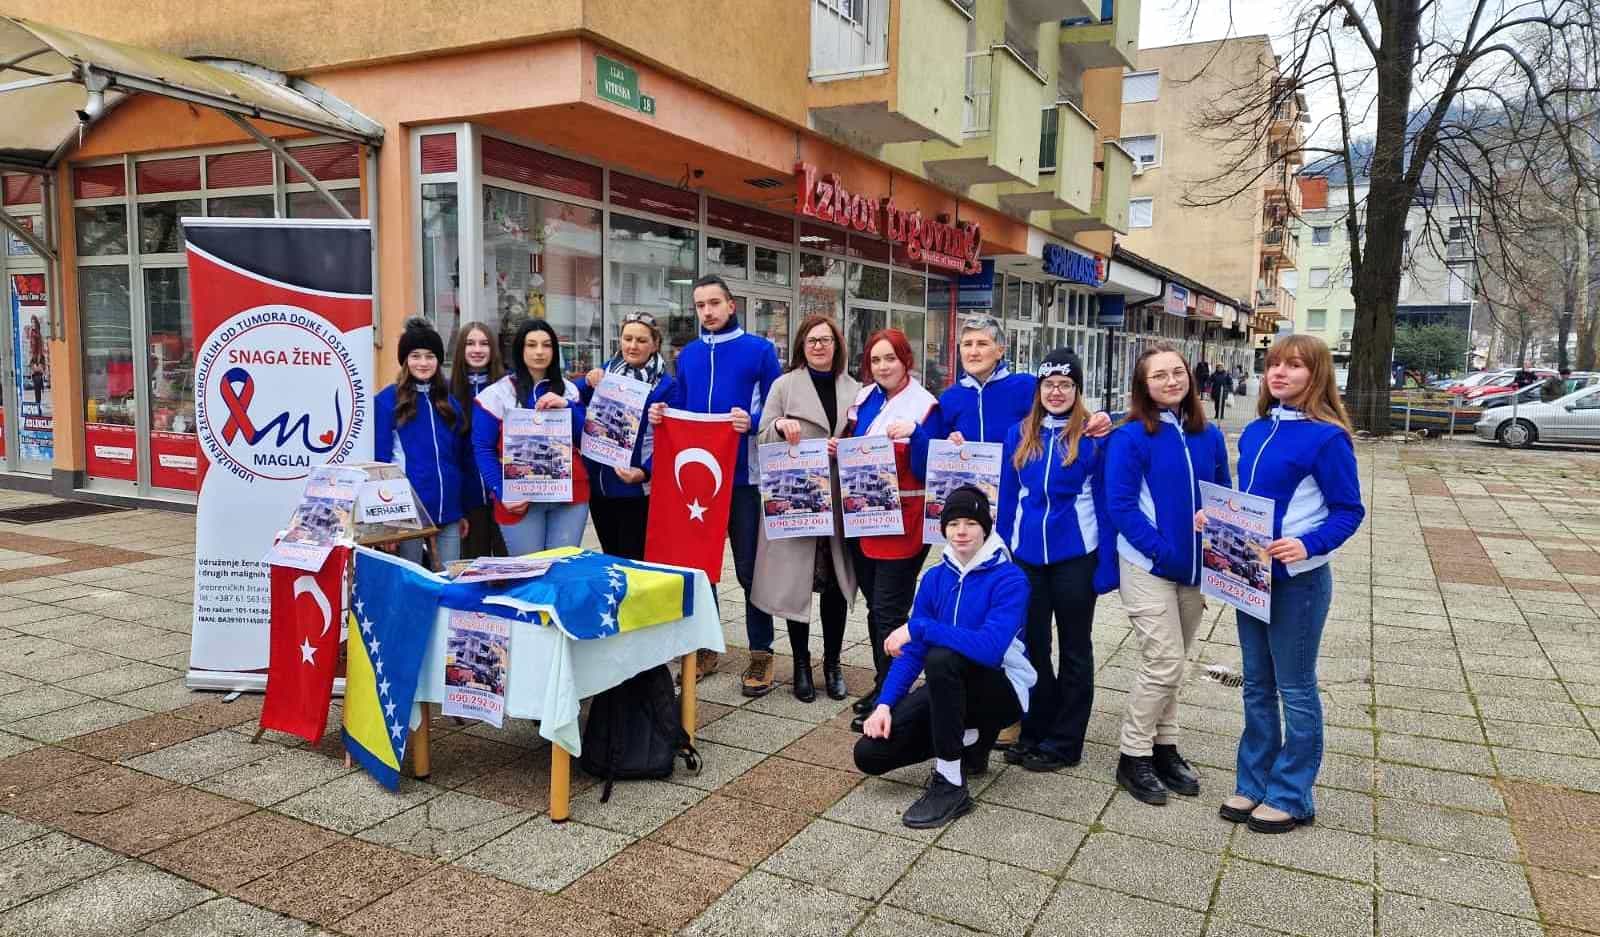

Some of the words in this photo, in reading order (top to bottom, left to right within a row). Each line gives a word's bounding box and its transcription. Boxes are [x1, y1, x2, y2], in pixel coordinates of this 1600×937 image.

[793, 161, 880, 234] Izbor
[197, 340, 223, 398] OBOLJELIH
[220, 327, 236, 343] OD
[236, 312, 287, 331] TUMORA
[290, 313, 322, 334] DOJKE
[328, 335, 360, 377] OSTALIH
[350, 378, 366, 440] MALIGNIH
[228, 349, 288, 365] SNAGA
[292, 346, 332, 366] ŽENE
[253, 453, 310, 468] MAGLAJ
